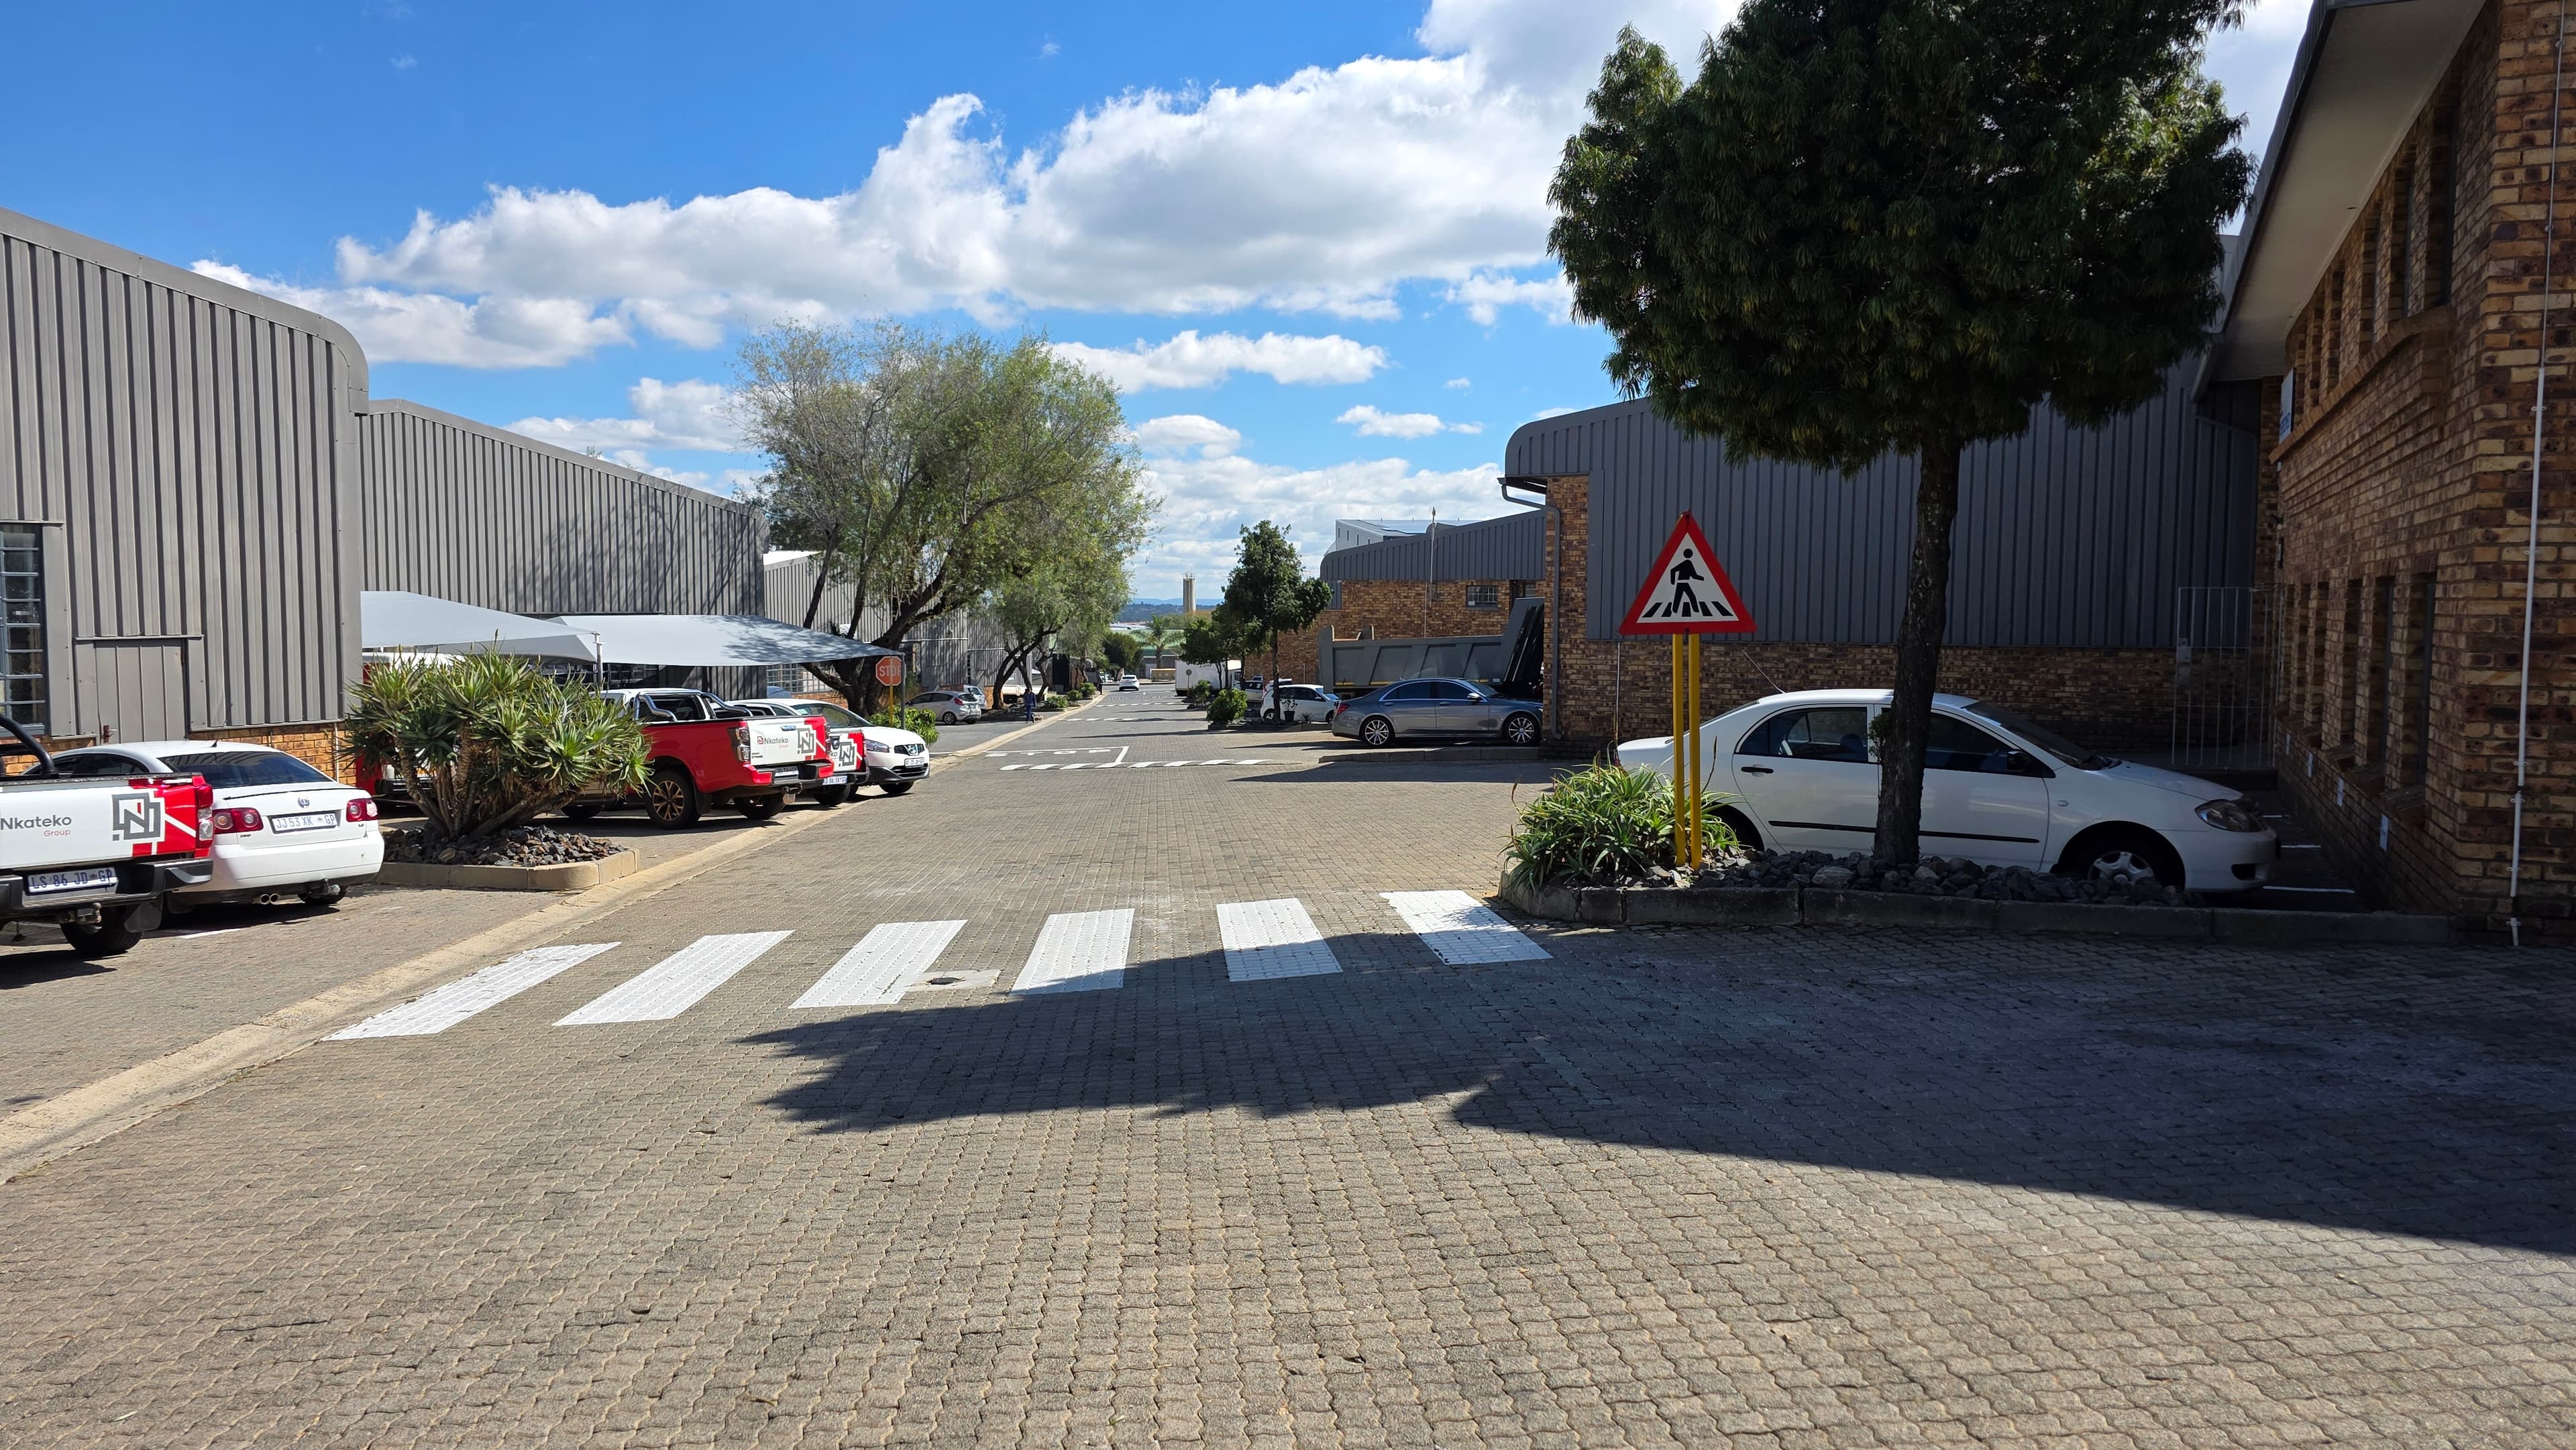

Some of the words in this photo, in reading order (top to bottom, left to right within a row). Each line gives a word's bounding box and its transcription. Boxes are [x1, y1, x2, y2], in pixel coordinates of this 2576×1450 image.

[764, 736, 789, 744] Nkateko
[0, 815, 72, 830] Nkateko
[276, 819, 287, 829] JJ
[289, 818, 301, 827] 53
[301, 816, 313, 826] XK
[324, 814, 335, 825] GP
[31, 876, 47, 889] LS
[53, 874, 68, 886] 86
[74, 872, 88, 885] JD
[99, 869, 113, 882] GP
